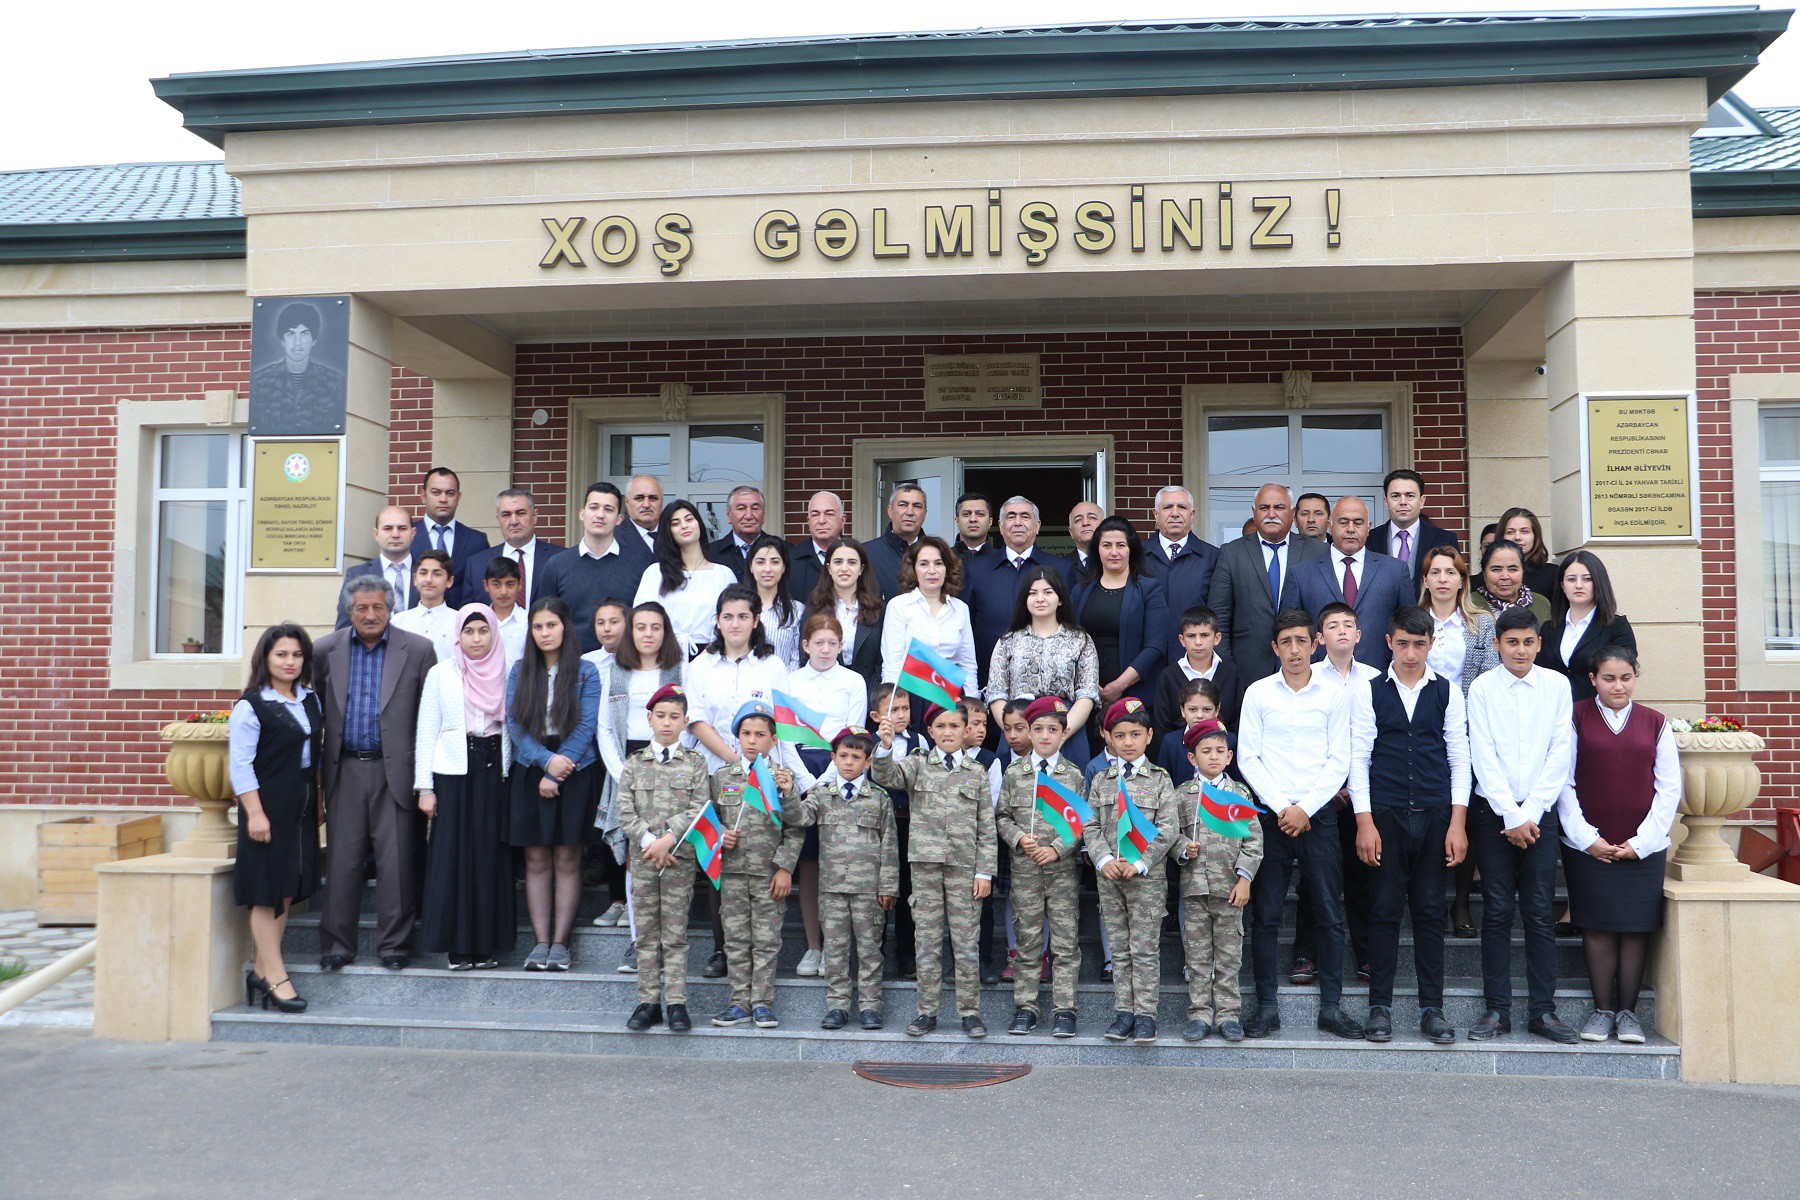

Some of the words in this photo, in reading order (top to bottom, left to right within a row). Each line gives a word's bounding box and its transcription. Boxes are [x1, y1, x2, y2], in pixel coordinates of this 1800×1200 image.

[538, 213, 694, 277] XOŞ
[1607, 464, 1632, 472] İLHAM
[1633, 464, 1671, 472] ƏLİYEVİN
